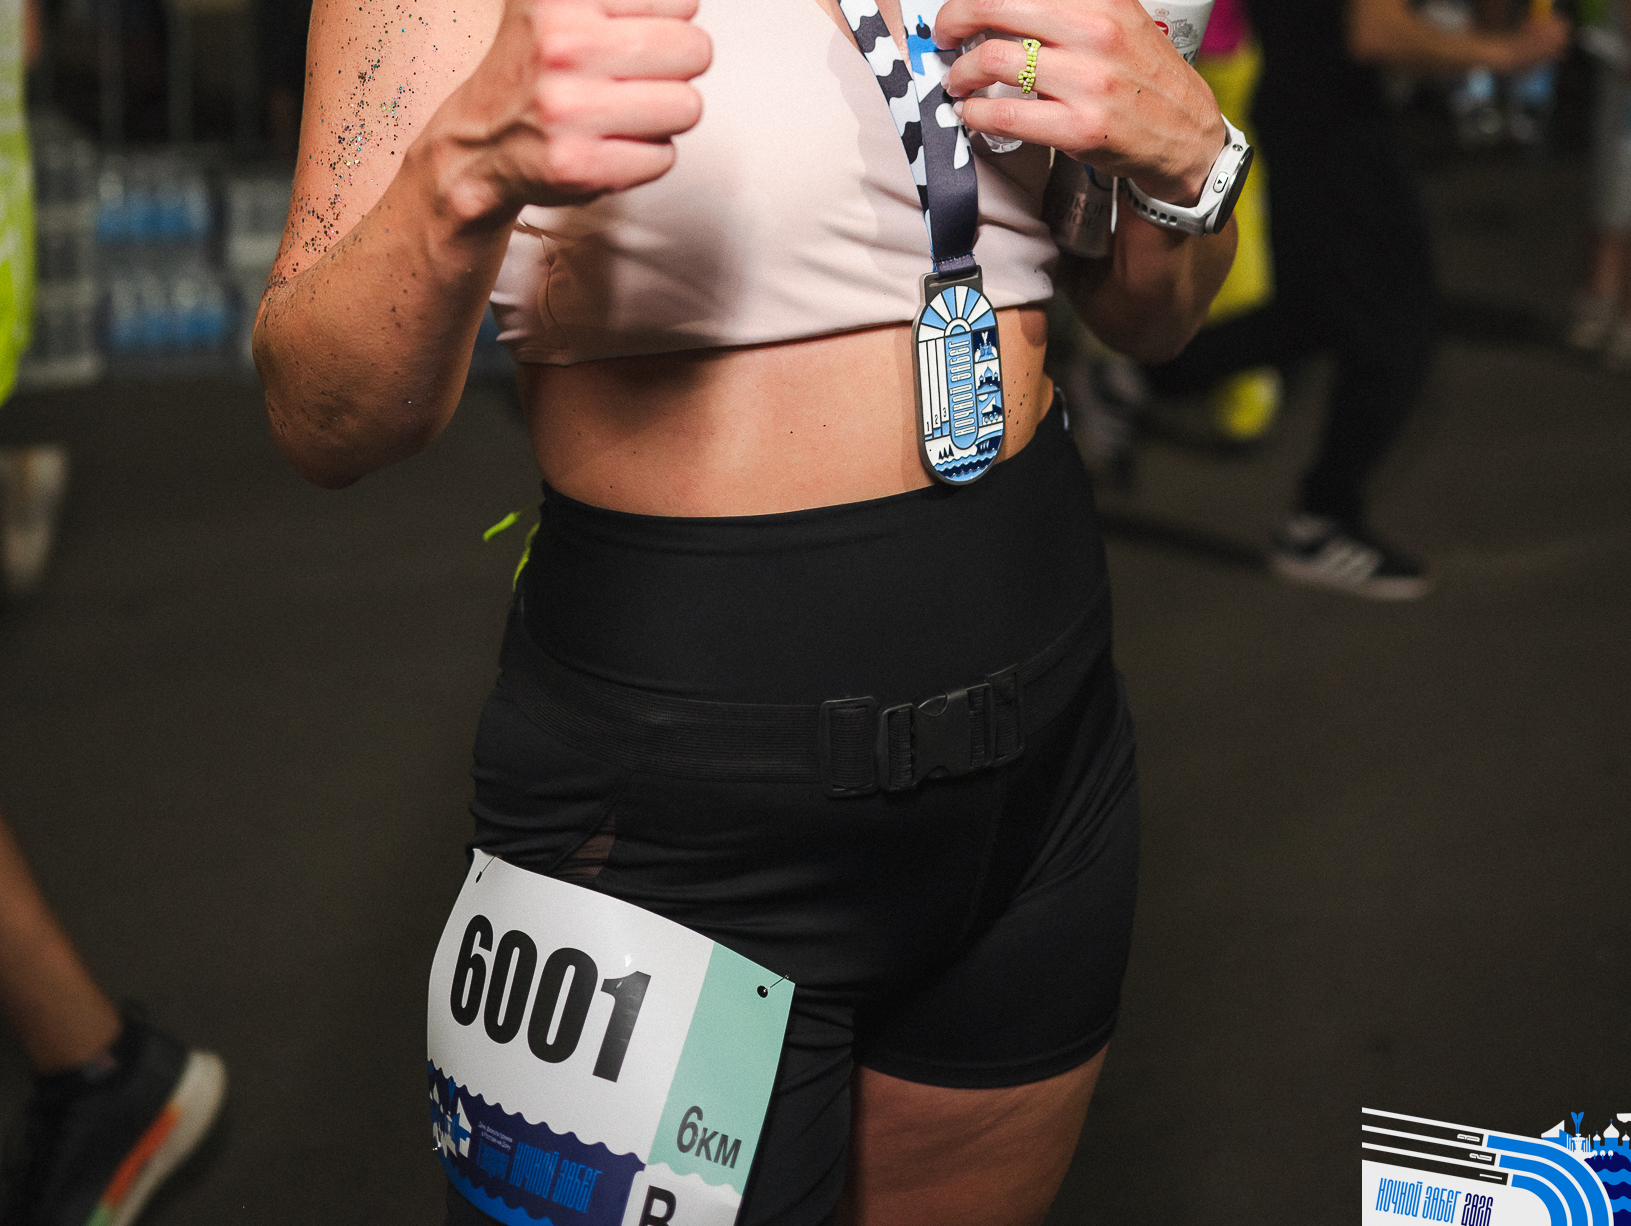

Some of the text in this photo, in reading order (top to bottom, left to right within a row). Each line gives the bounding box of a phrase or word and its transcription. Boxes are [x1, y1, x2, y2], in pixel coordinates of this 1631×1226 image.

[948, 340, 976, 437] НОЧНОЙ ЗАБЕГ
[450, 914, 652, 1083] 6001
[552, 1159, 603, 1213] ЗАБЕГ
